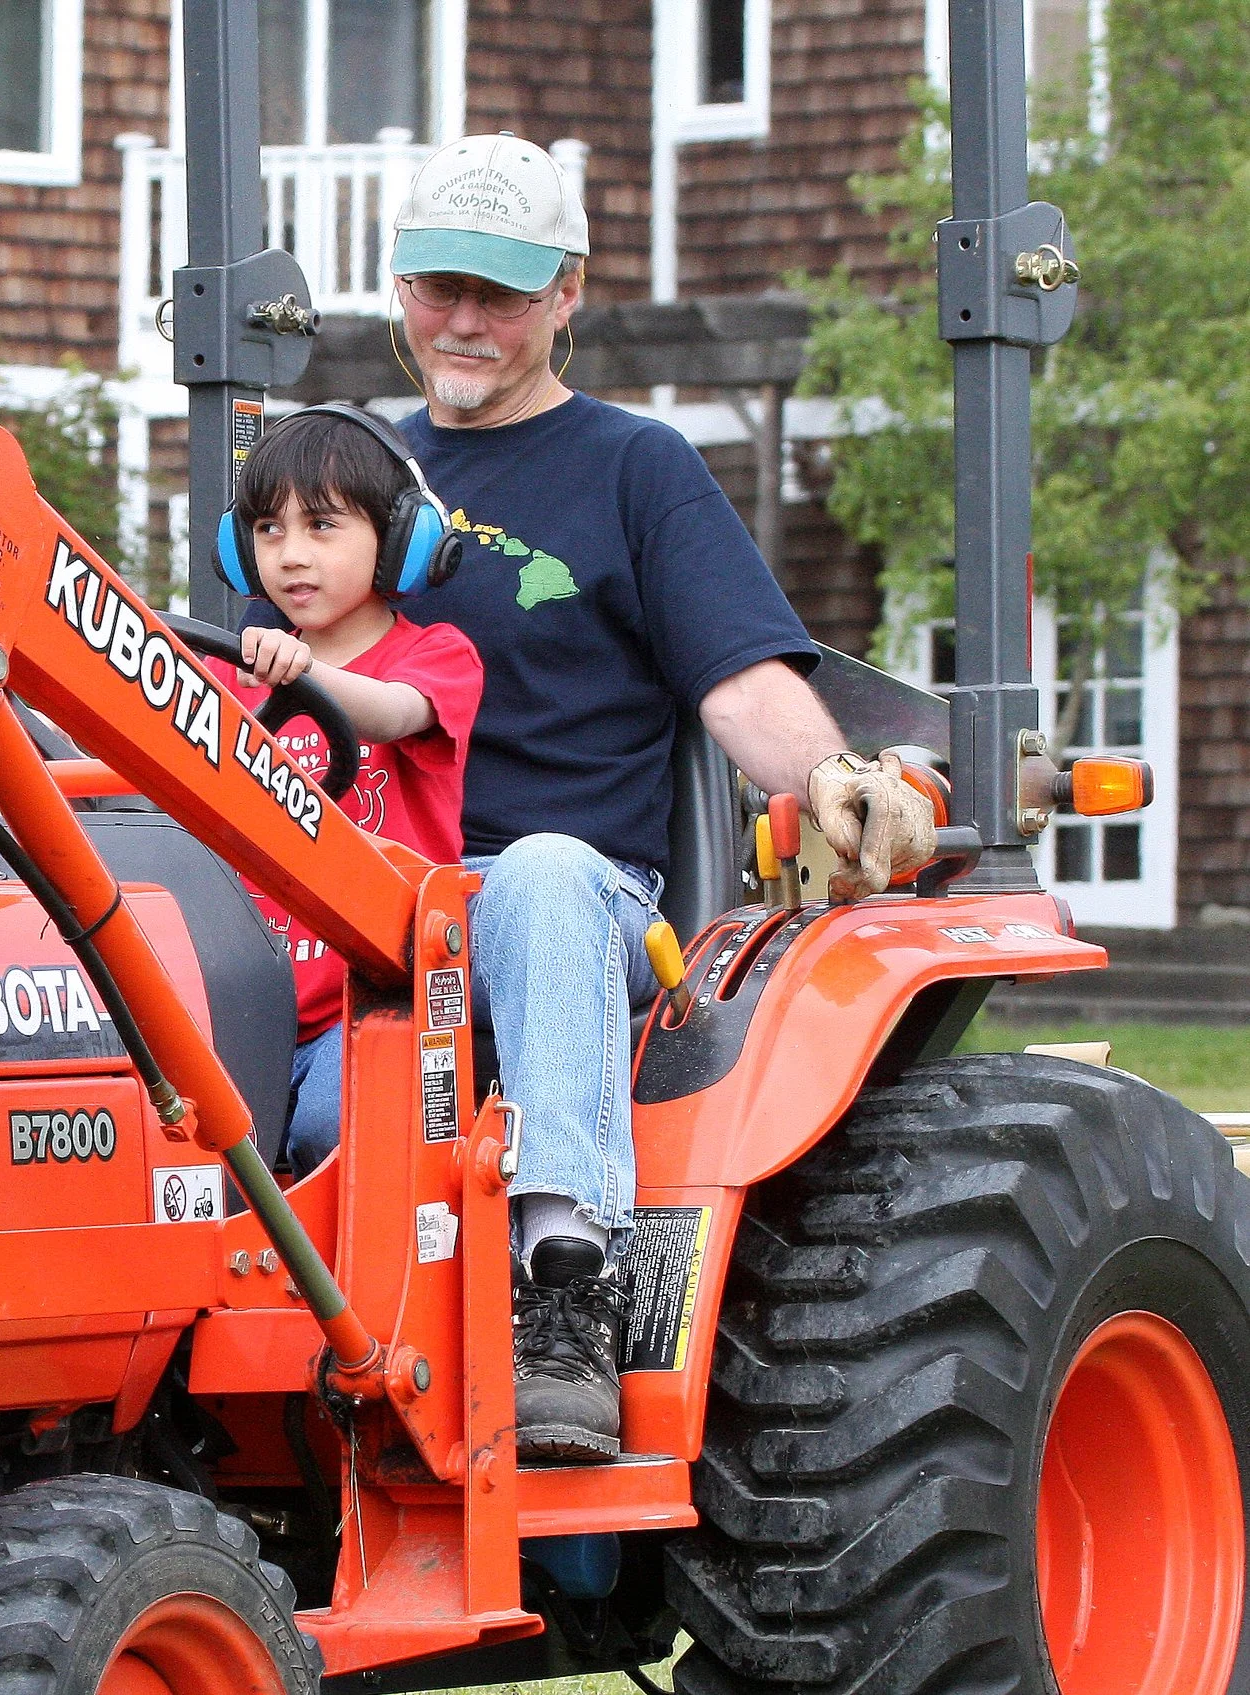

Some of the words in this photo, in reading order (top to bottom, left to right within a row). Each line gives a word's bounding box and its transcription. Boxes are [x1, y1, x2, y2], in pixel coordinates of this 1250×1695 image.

[432, 168, 484, 200] COUNTRY
[488, 168, 531, 214] TRACTOR
[468, 182, 505, 195] GARDEN
[45, 533, 223, 770] KUBOTA
[232, 714, 324, 843] LA402
[937, 925, 998, 944] HST
[10, 1108, 117, 1165] B7800
[680, 1258, 701, 1330] CAUTION
